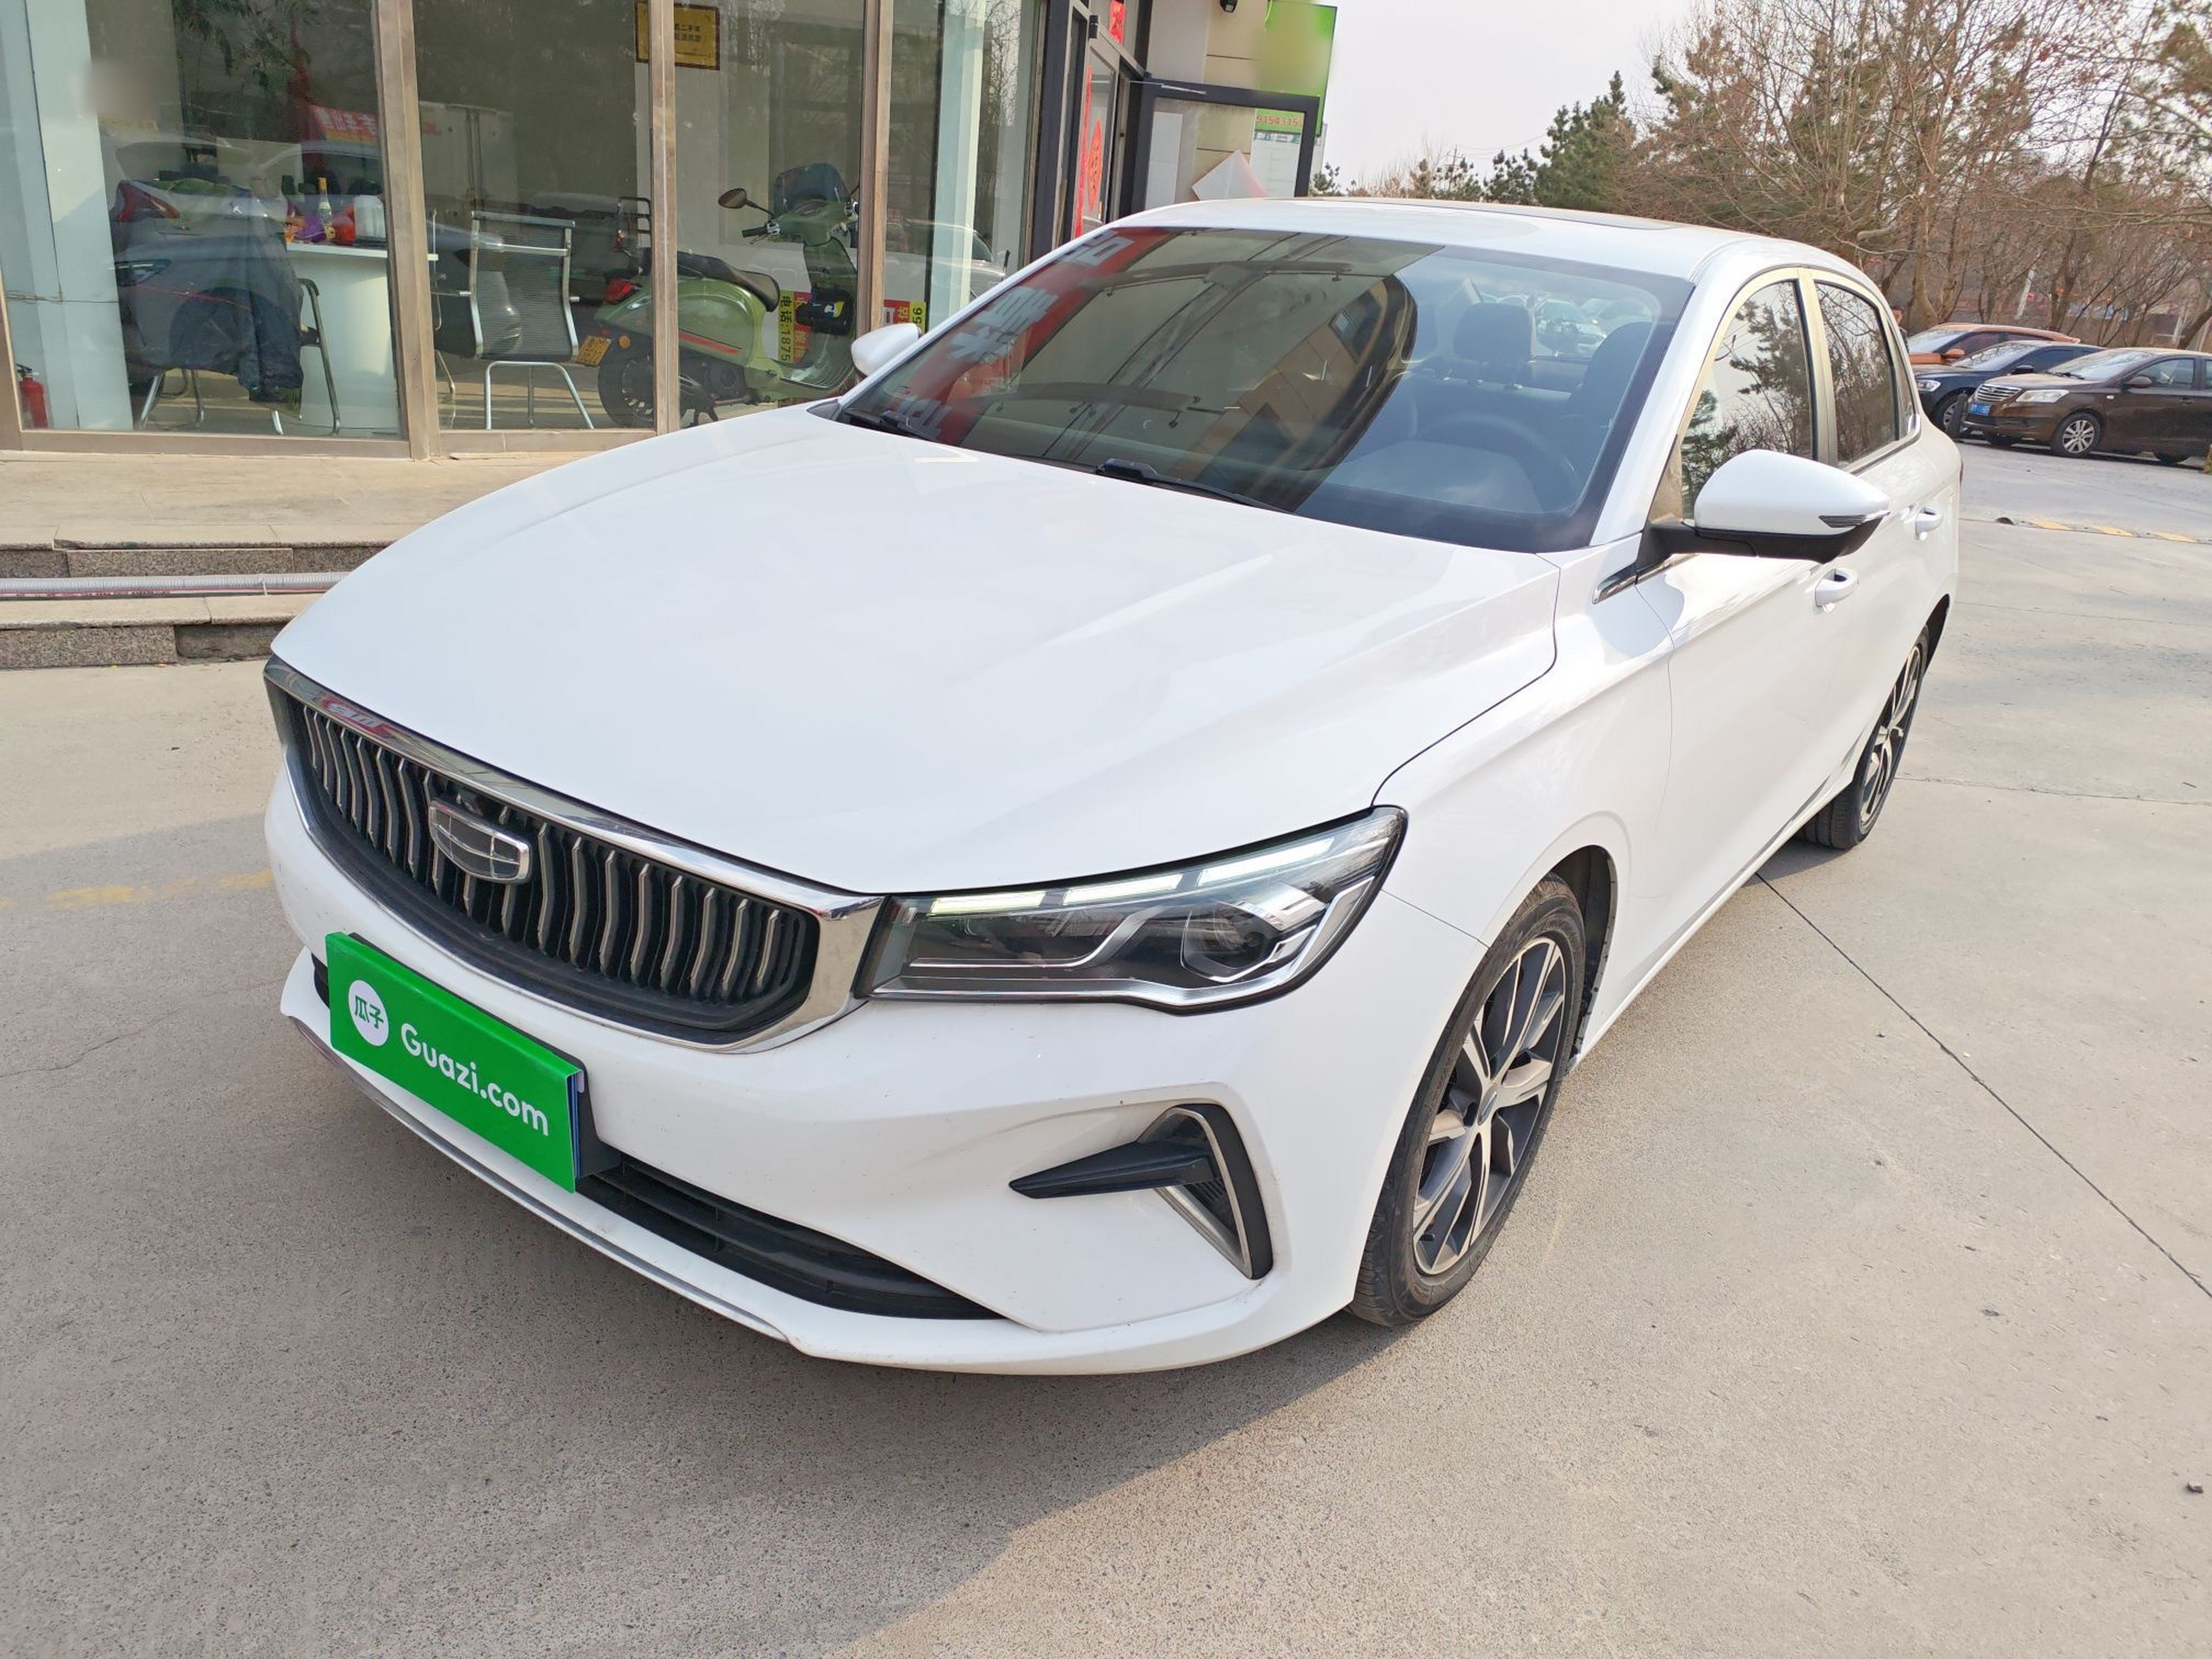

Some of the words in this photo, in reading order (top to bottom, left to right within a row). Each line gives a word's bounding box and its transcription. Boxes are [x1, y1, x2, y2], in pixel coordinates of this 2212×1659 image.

[779, 295, 792, 362] 电话:1875
[355, 995, 384, 1029] 瓜子
[401, 1022, 548, 1137] Guazi.com
